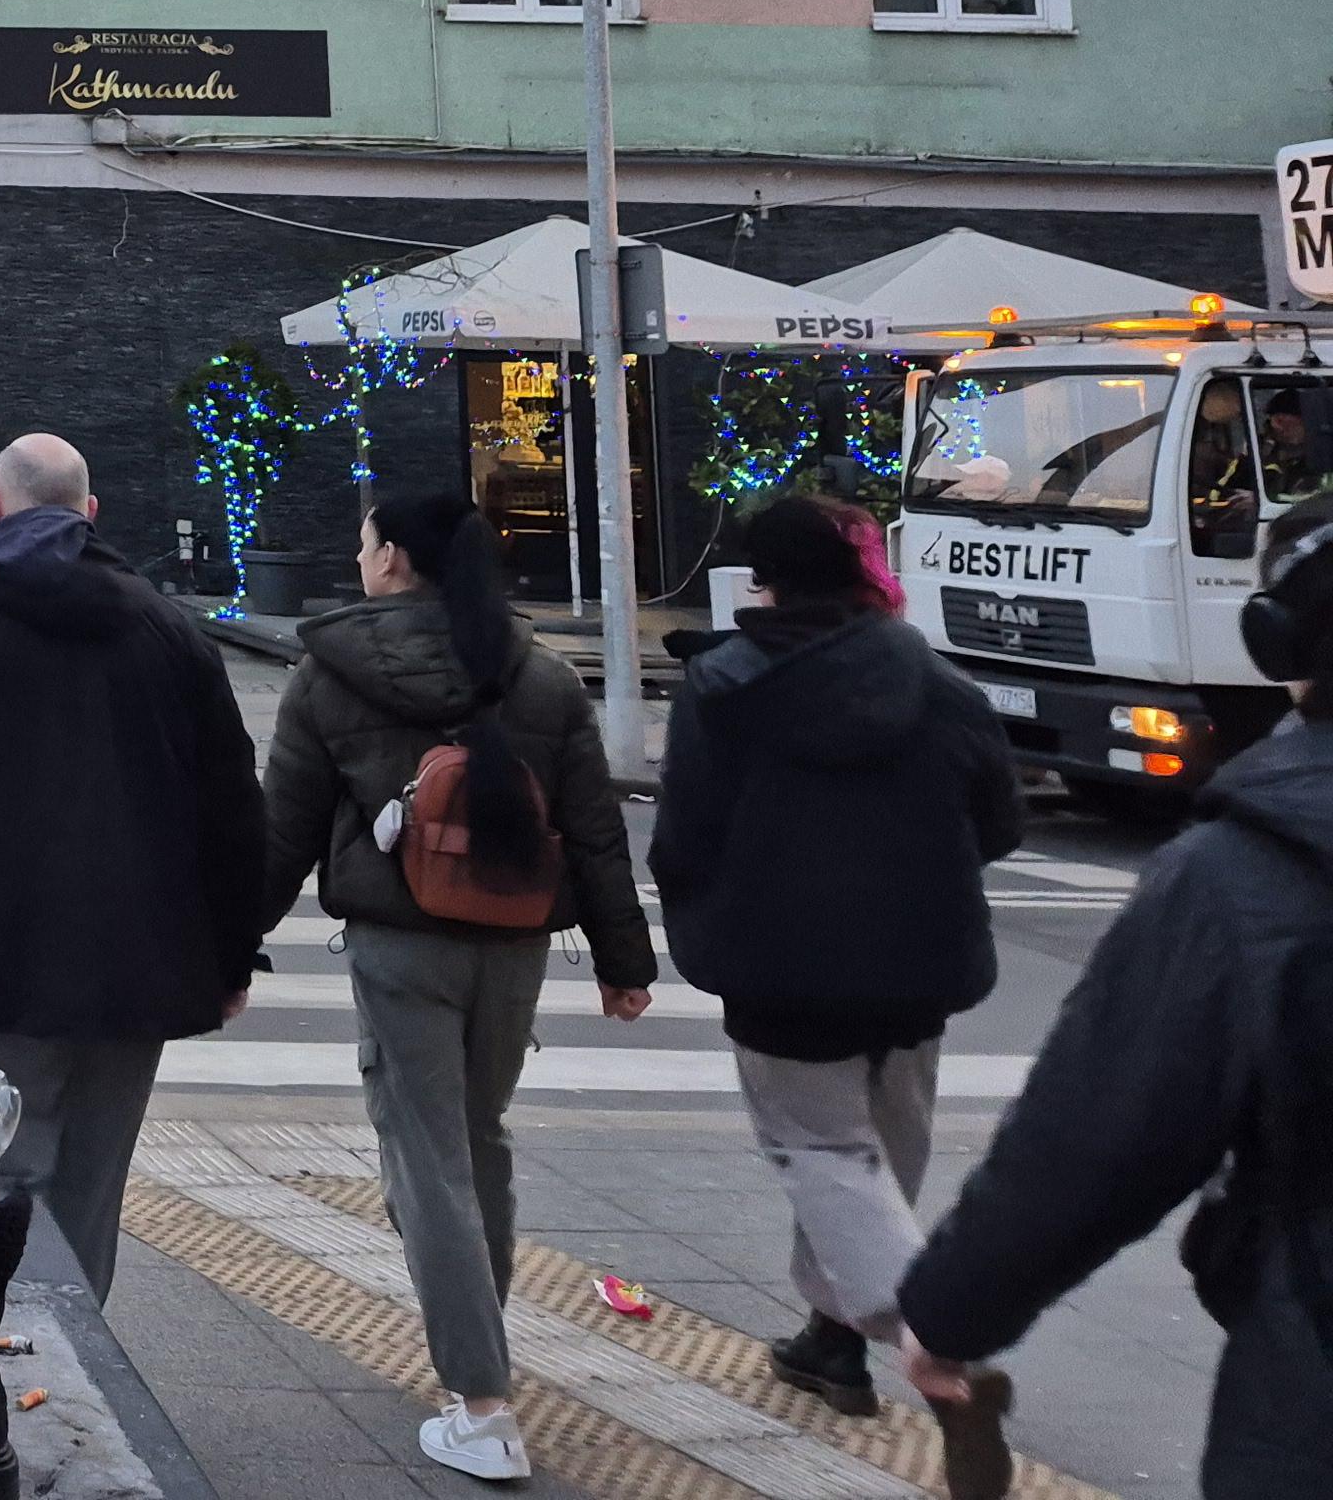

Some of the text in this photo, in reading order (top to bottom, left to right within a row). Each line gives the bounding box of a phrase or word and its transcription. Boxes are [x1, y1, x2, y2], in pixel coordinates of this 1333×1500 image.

[91, 33, 198, 46] RESTAURACJA
[48, 62, 240, 110] Kathmandu
[402, 310, 446, 332] PEPSI
[775, 317, 874, 339] PEPSI
[978, 602, 1040, 627] MAN
